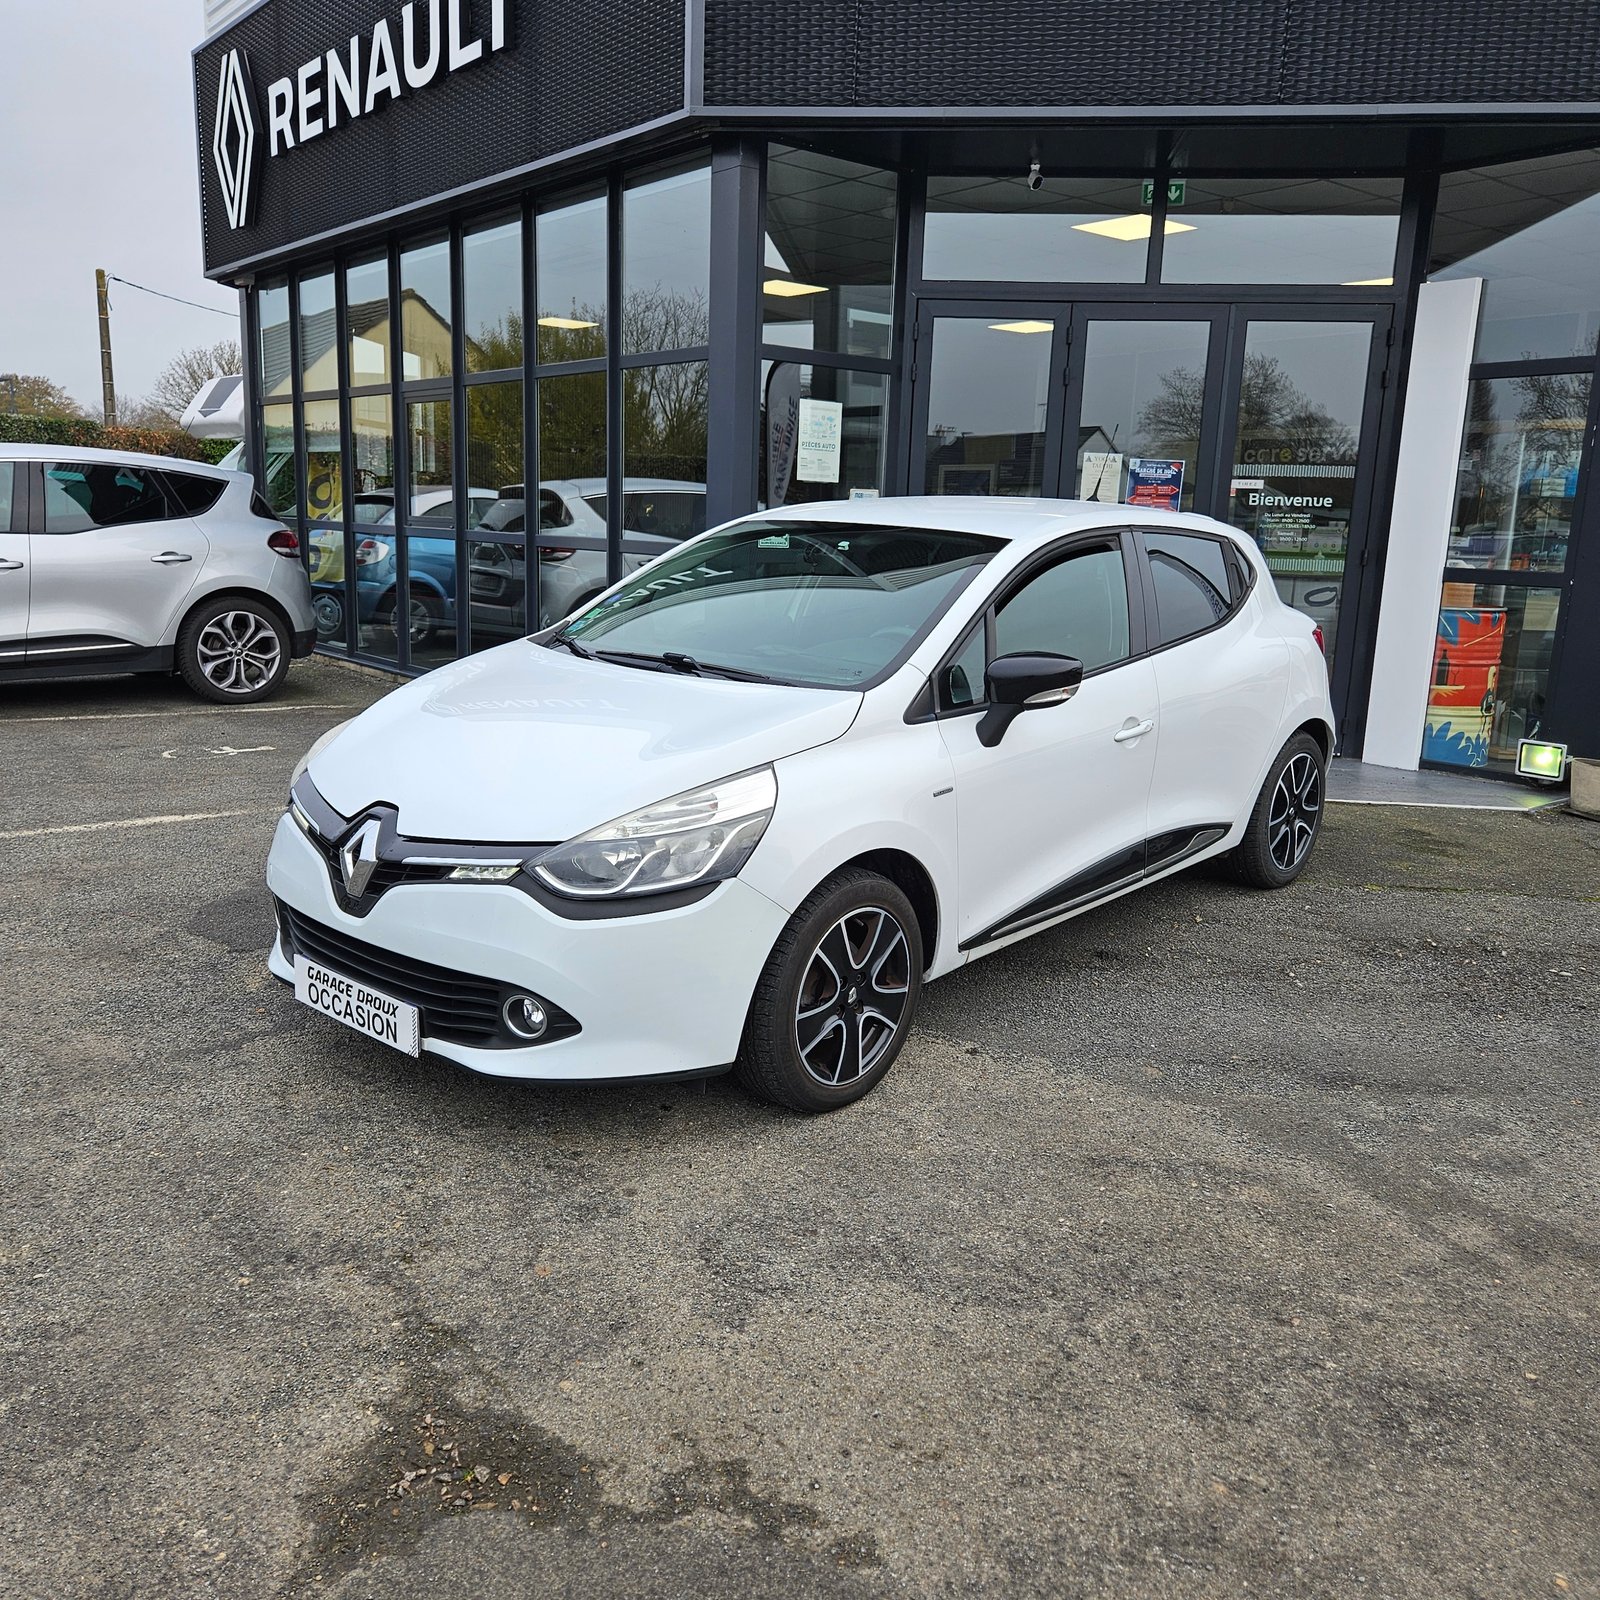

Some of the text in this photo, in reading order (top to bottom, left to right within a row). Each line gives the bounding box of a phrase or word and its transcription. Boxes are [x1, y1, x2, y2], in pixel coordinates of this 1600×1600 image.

[1249, 493, 1333, 507] Bienvenue
[307, 966, 399, 1018] GARAGE DROUX
[308, 983, 397, 1043] OCCASION
